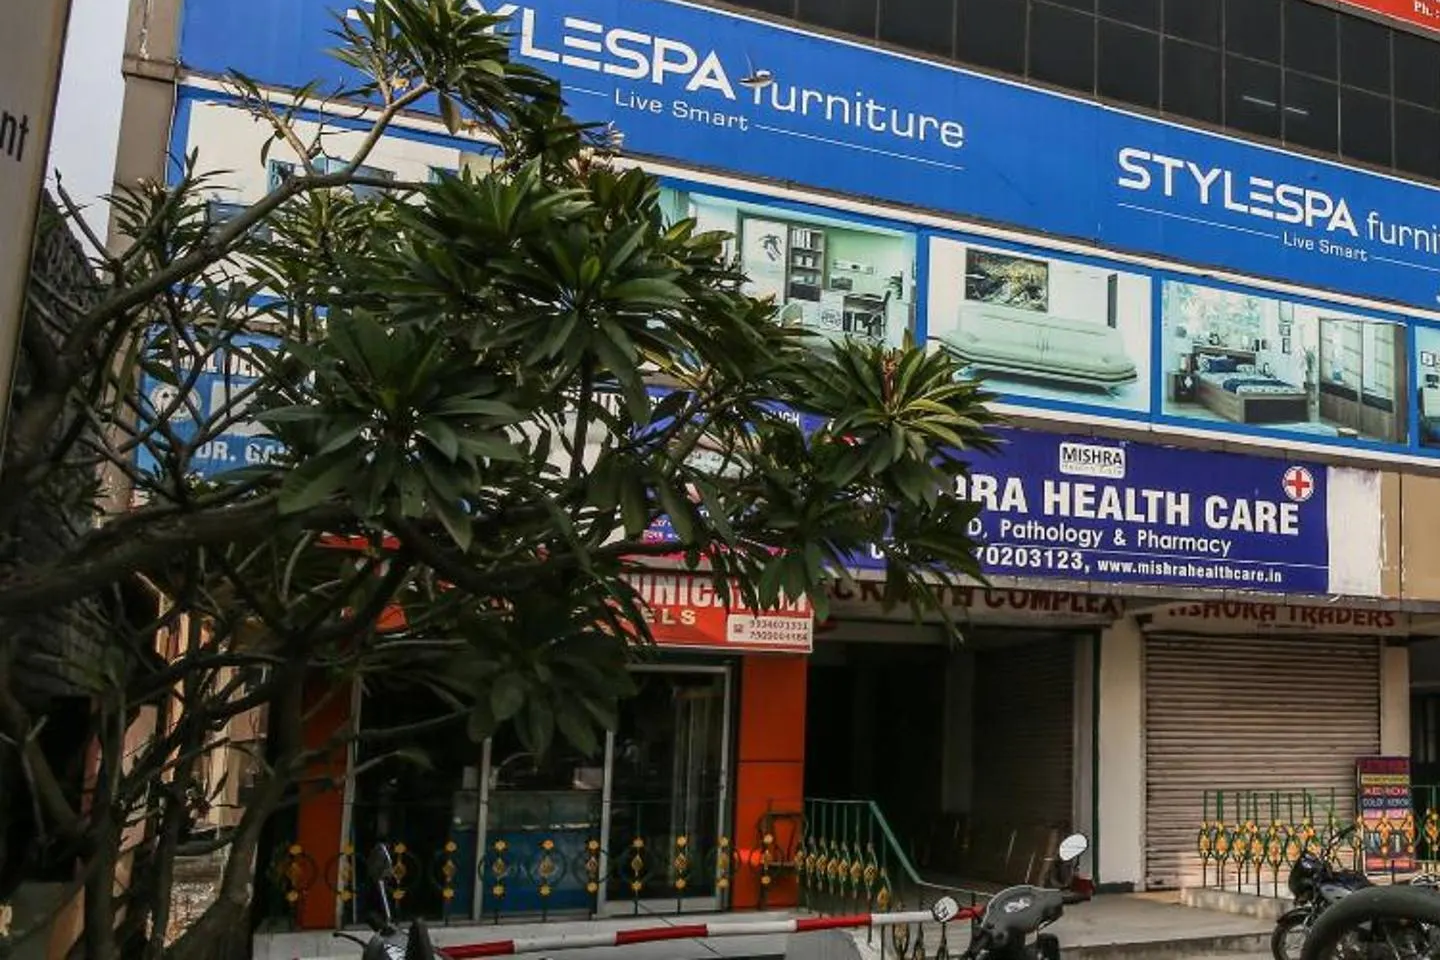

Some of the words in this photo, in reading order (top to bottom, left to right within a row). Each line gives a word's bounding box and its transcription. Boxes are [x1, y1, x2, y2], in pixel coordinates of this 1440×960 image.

[614, 88, 664, 116] Live
[672, 100, 750, 132] Smart
[749, 69, 966, 149] furniture
[1118, 147, 1359, 238] STYLESPA
[1283, 231, 1314, 252] Live
[1319, 240, 1368, 262] Smart
[1062, 446, 1122, 466] MISHRA
[1044, 480, 1190, 528] HEALTH
[1205, 495, 1299, 536] CARE
[1000, 520, 1104, 549] Pathology
[1113, 528, 1127, 547] &
[1137, 529, 1232, 559] Pharmacy
[1098, 559, 1282, 585] www.mishrahealthcare.in
[985, 588, 1117, 618] COMPLEX
[1287, 604, 1396, 629] TRADERS
